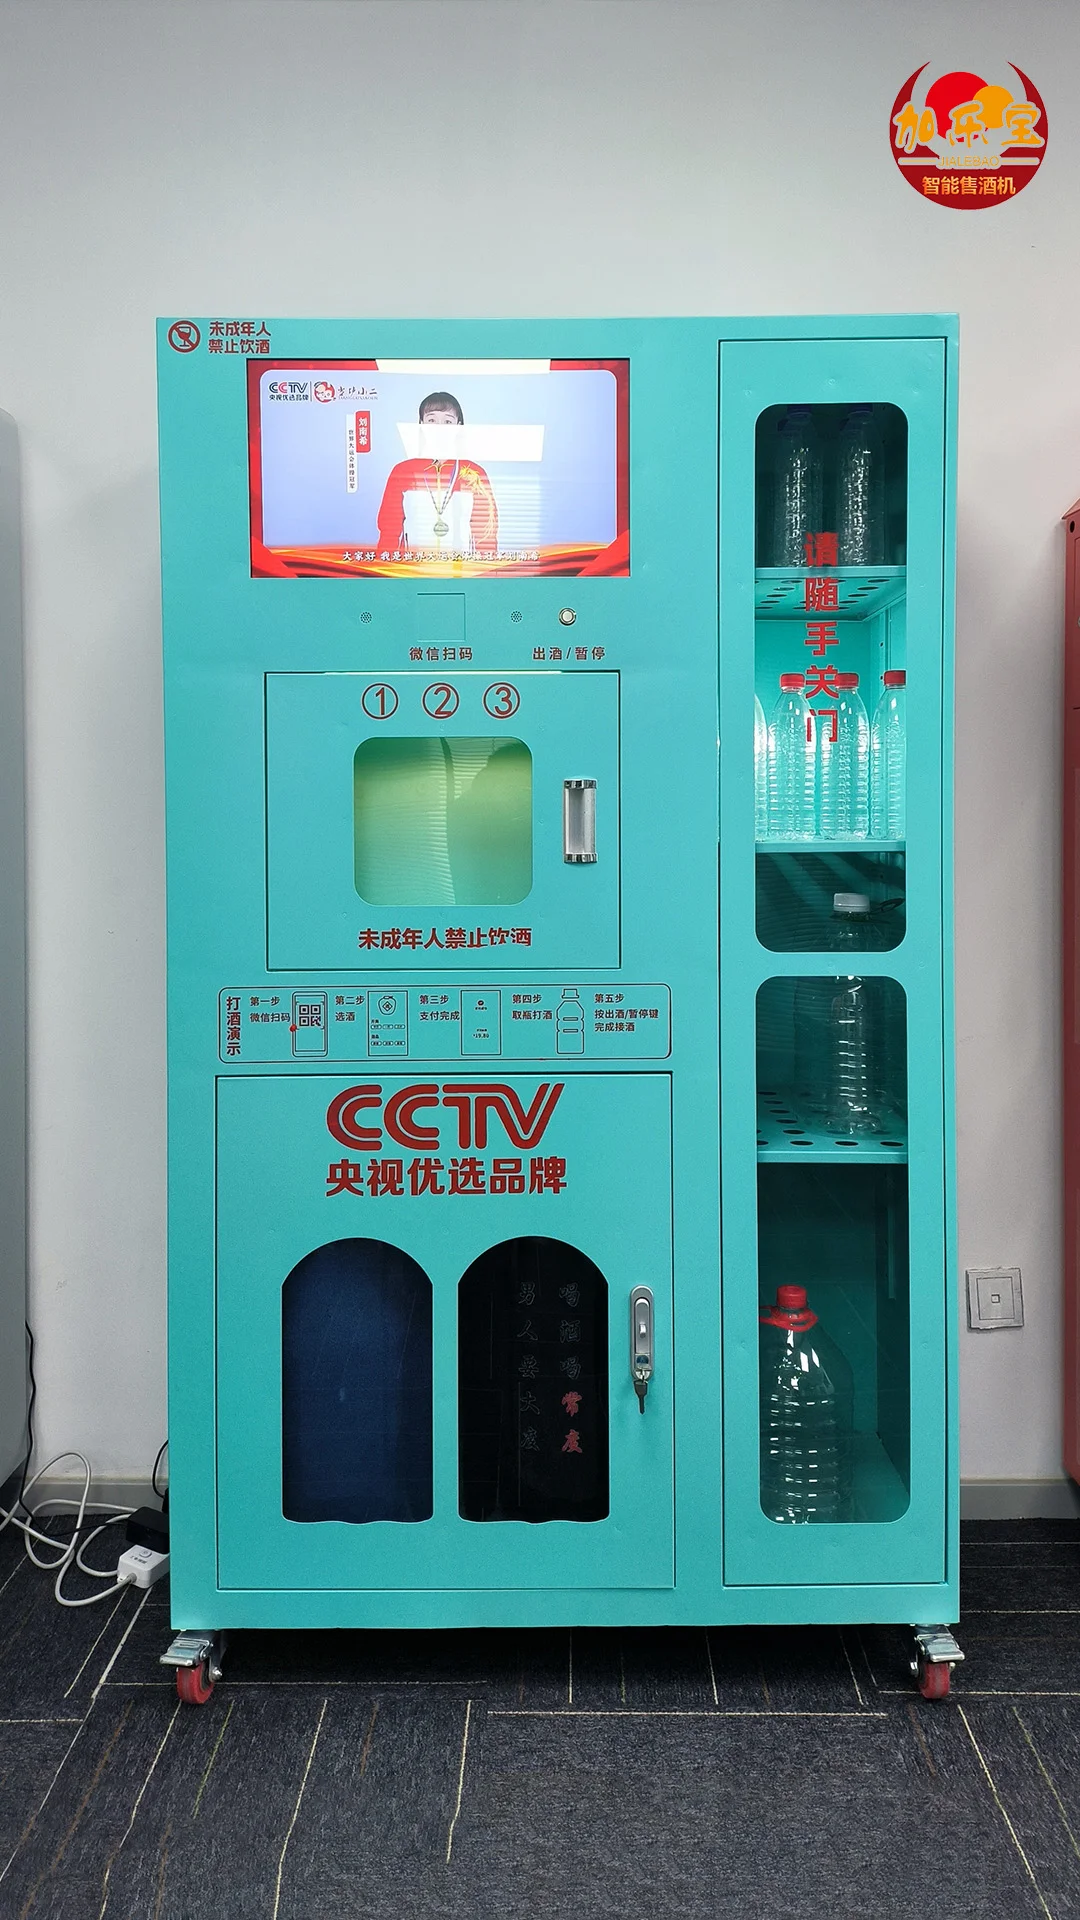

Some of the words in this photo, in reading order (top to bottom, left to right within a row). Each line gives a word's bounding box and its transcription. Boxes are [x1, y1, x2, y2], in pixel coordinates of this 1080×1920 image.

[209, 321, 271, 337] 未成年人
[208, 339, 270, 354] 禁止饮酒
[269, 382, 308, 393] CCTV
[343, 551, 376, 561] 大家好
[804, 532, 839, 743] 请随手关门
[409, 647, 473, 660] 微信扫码
[532, 647, 605, 660] 出酒/暂停
[358, 927, 532, 950] 未成年人禁止饮酒
[250, 996, 280, 1006] 第一步
[335, 995, 365, 1005] 第二步
[419, 994, 449, 1005] 第三步
[512, 994, 542, 1004] 第四步
[594, 993, 625, 1004] 第五步
[250, 1012, 291, 1022] 微信扫码
[335, 1012, 356, 1022] 选酒
[419, 1011, 460, 1021] 支付完成
[512, 1010, 553, 1020] 取瓶打酒
[594, 1009, 659, 1020] 按出酒/暂停键
[226, 996, 241, 1056] 打酒演示
[594, 1022, 635, 1032] 完成接酒
[326, 1083, 565, 1151] CCTV
[326, 1156, 567, 1197] 央视优选品牌
